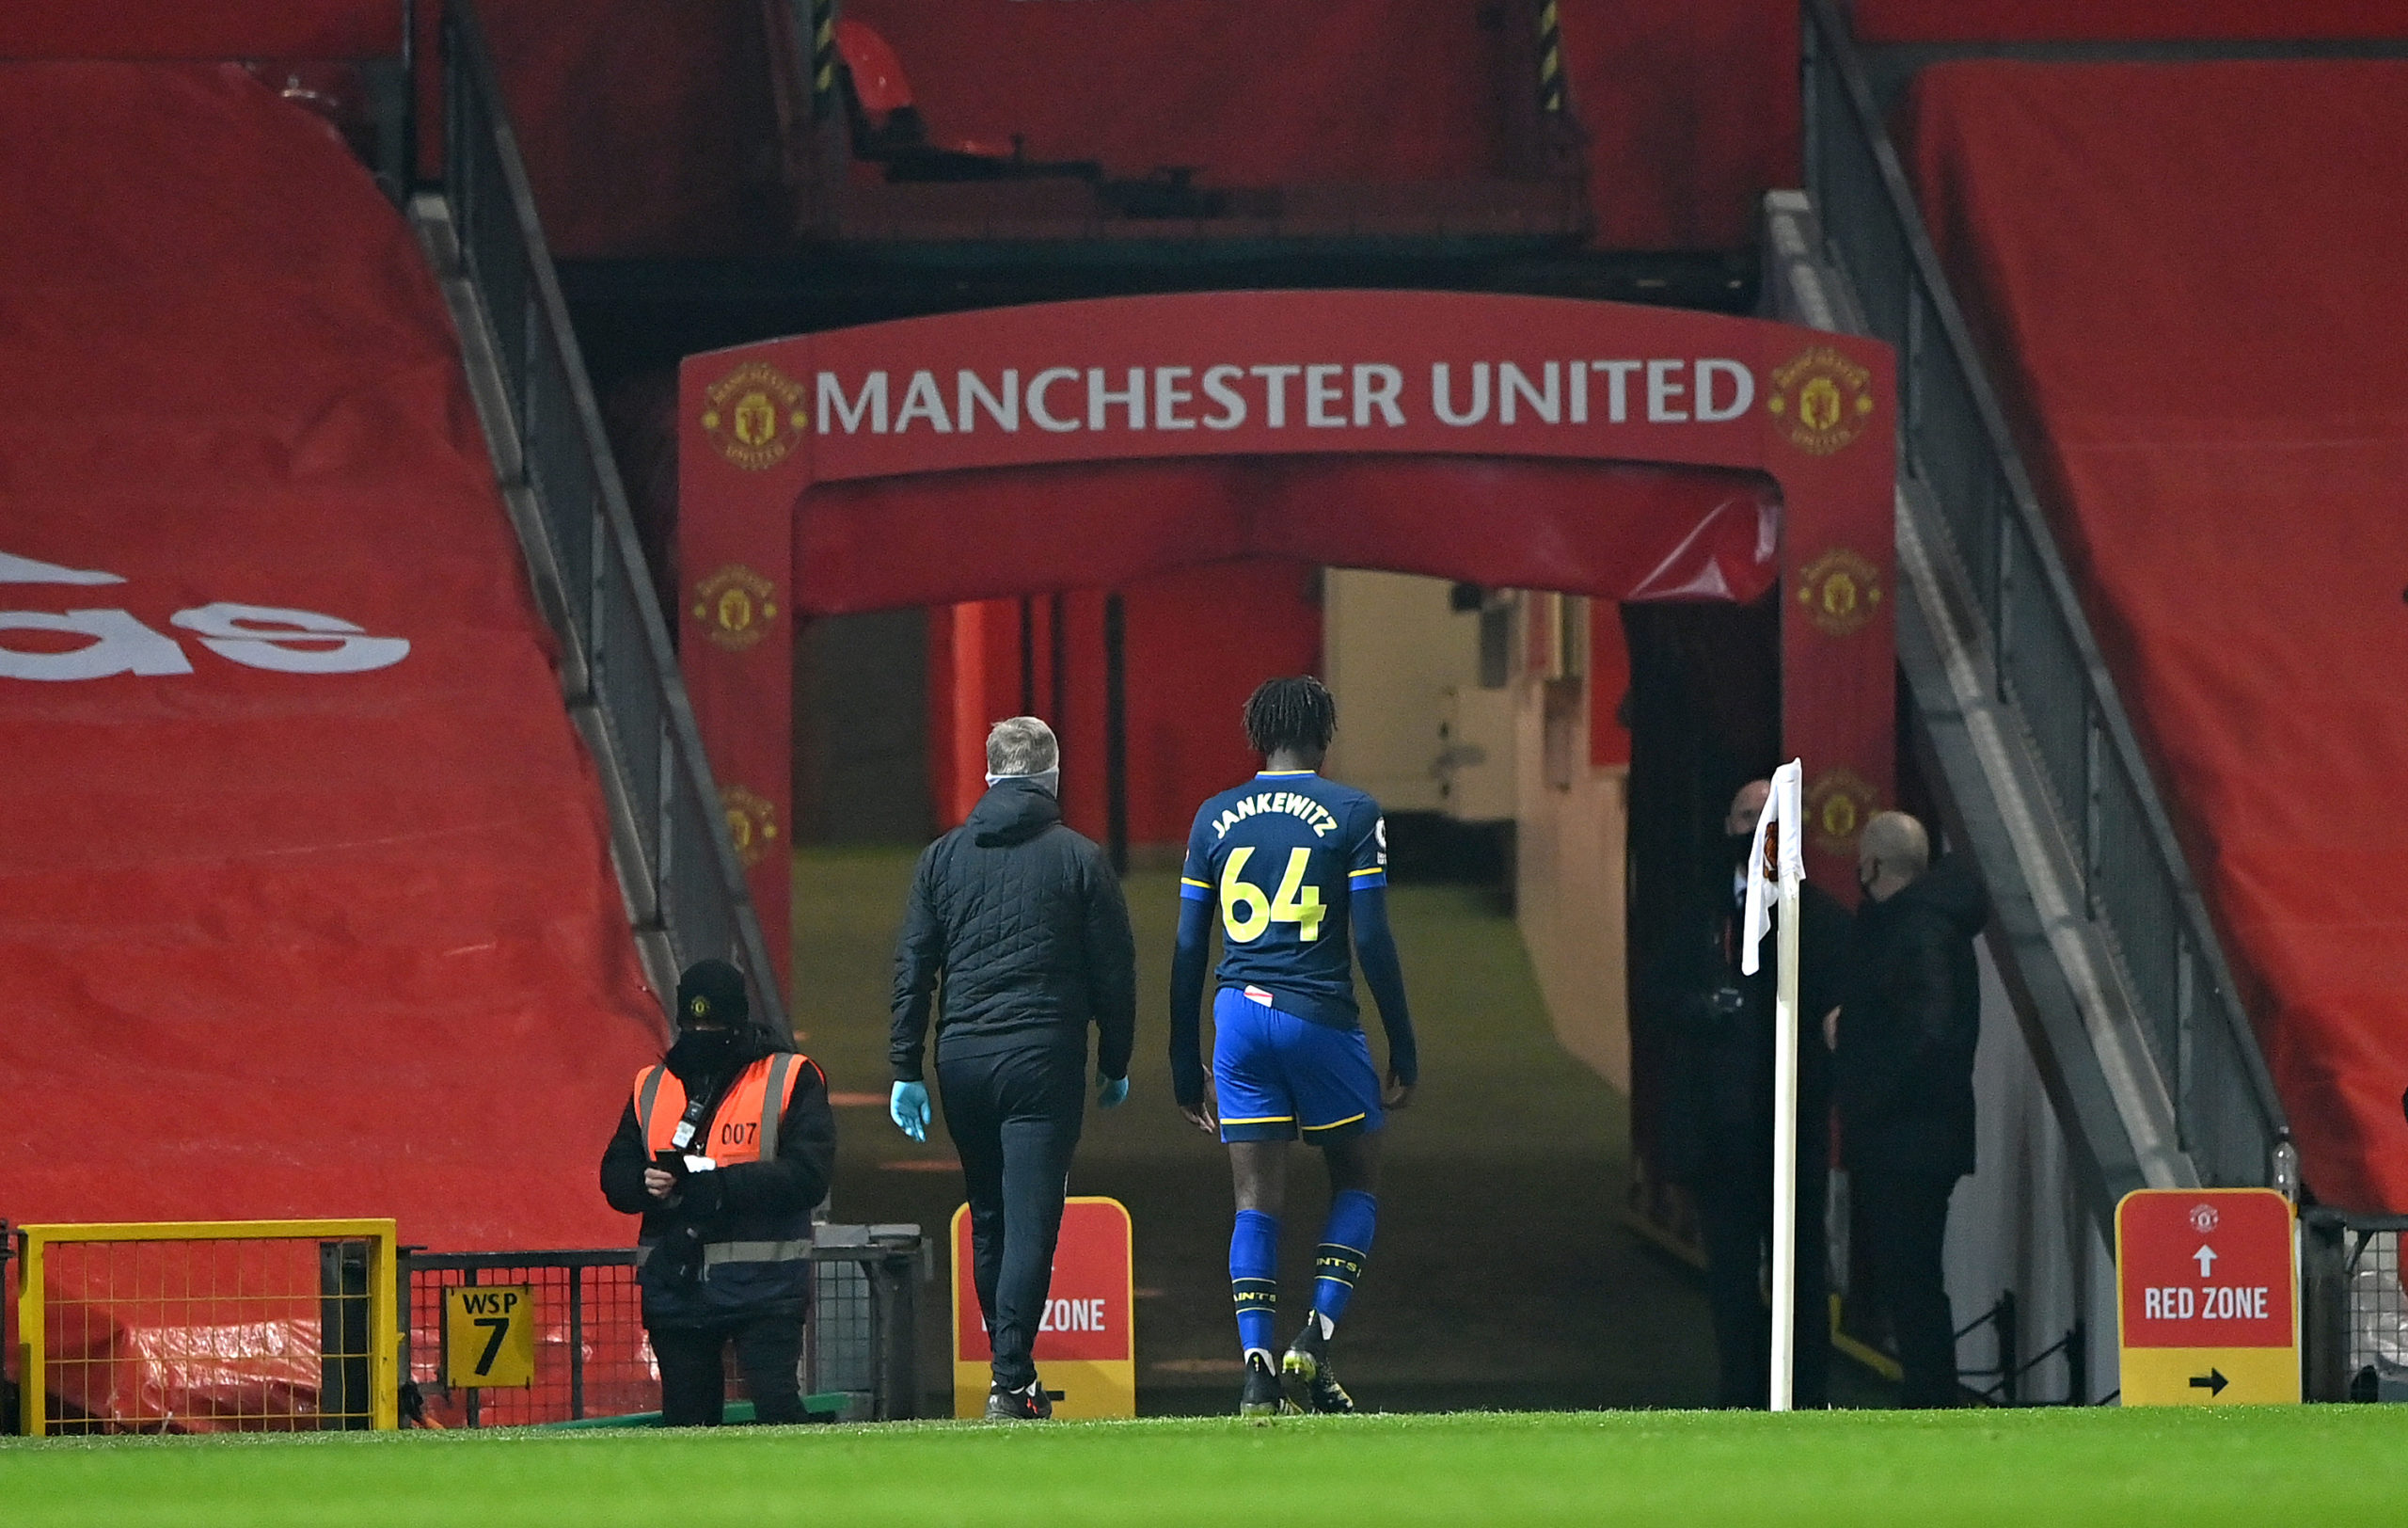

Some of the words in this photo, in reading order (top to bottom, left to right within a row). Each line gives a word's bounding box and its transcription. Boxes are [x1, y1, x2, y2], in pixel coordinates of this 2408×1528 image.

[816, 362, 1406, 435] MANCHESTER
[1432, 358, 1755, 427] UNITED
[1212, 792, 1338, 839] JANKEWITZ
[1220, 847, 1327, 943] 64
[721, 1122, 757, 1145] 007
[462, 1293, 518, 1314] WSP
[1038, 1298, 1106, 1331] ZONE
[2145, 1287, 2194, 1319] RED
[2201, 1287, 2269, 1319] ZONE
[473, 1317, 510, 1377] 7
